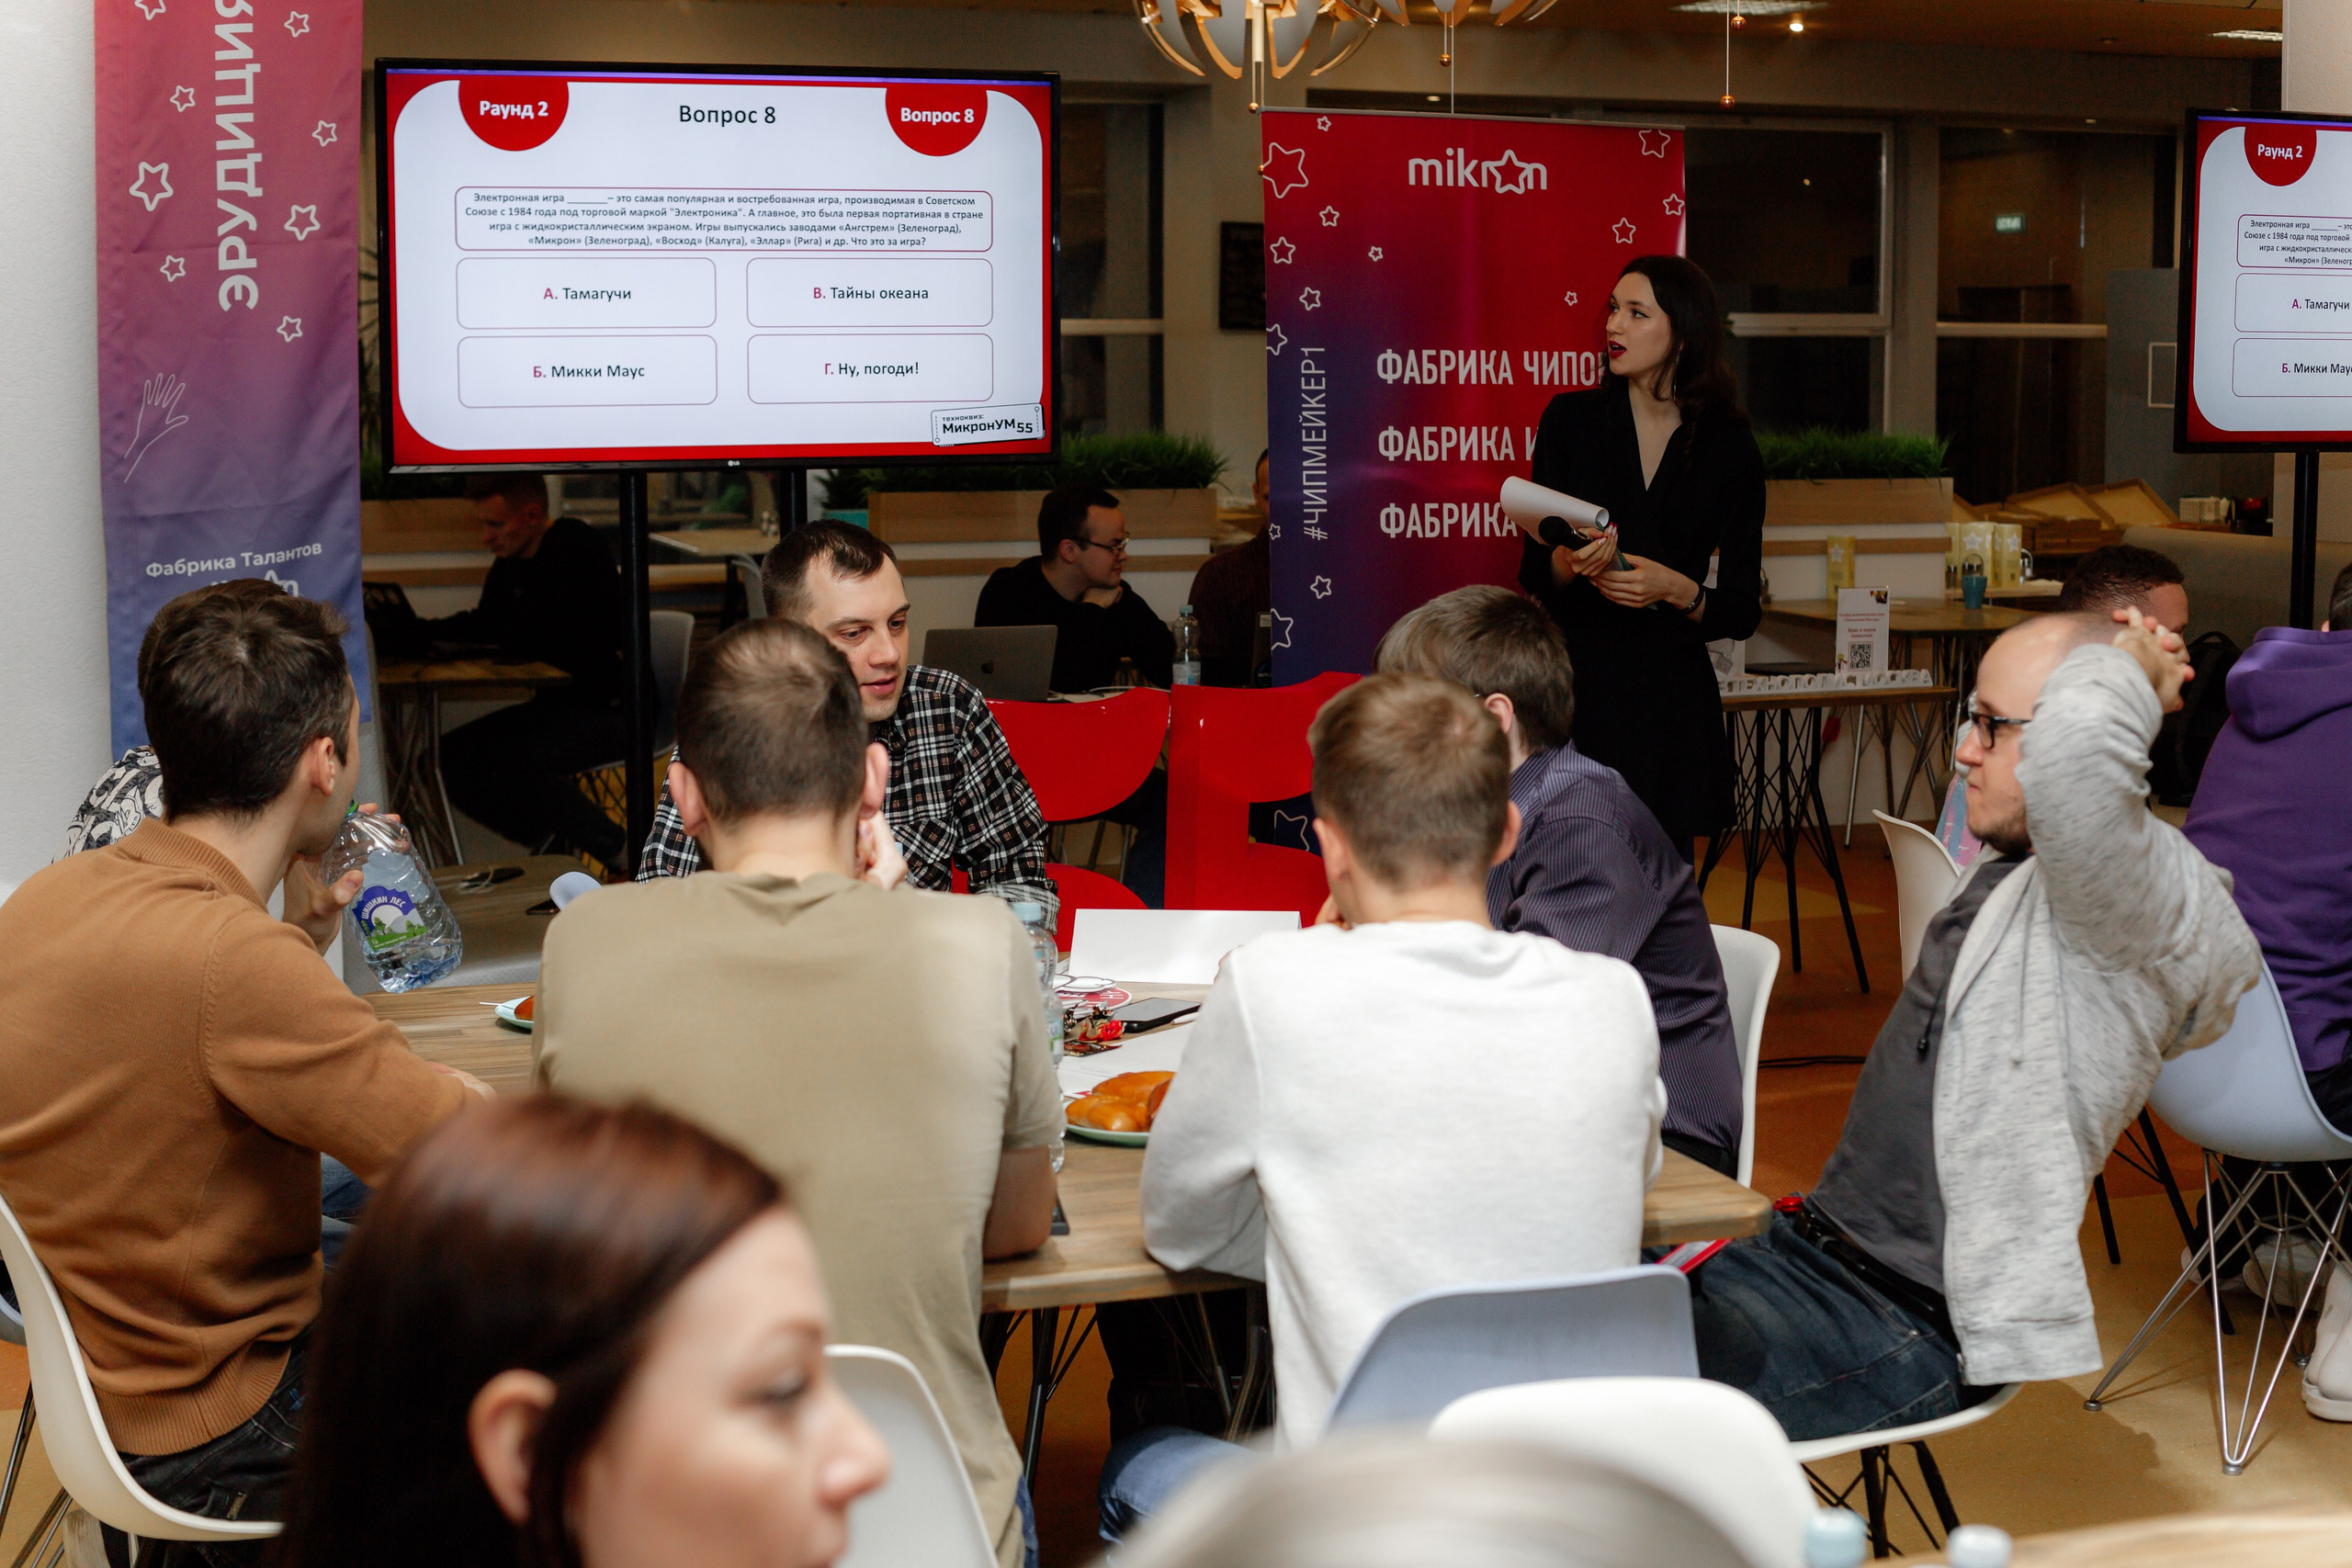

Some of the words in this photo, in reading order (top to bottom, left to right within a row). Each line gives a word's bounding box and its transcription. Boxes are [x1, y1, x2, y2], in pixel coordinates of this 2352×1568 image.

[479, 99, 534, 120] Раунд
[537, 101, 548, 118] 2
[678, 104, 759, 129] Вопрос
[763, 106, 776, 124] 8
[900, 106, 959, 127] Вопрос
[963, 107, 975, 123] 8
[215, 0, 263, 311] ЭРУДИЦИЯ
[2257, 143, 2294, 161] Раунд
[2296, 145, 2302, 158] 2
[474, 193, 539, 203] Электронная
[542, 196, 564, 204] игра
[667, 197, 725, 205] популярная
[737, 195, 815, 205] востребованная
[818, 197, 842, 206] игра,
[845, 197, 915, 206] производимая
[926, 197, 975, 205] Советском
[466, 208, 497, 216] Союзе
[509, 208, 531, 216] 1984
[535, 209, 557, 218] года
[560, 209, 579, 218] под
[581, 208, 626, 218] торговой
[629, 208, 667, 218] маркой
[670, 209, 745, 219] "Электроника".
[748, 209, 755, 217] А
[758, 210, 798, 219] главное,
[819, 209, 843, 218] была
[846, 211, 879, 220] первая
[882, 211, 942, 220] портативная
[952, 212, 983, 220] стране
[522, 224, 644, 232] жидкокристаллическим
[647, 224, 692, 232] экраном.
[695, 223, 720, 232] Игры
[724, 224, 786, 232] выпускались
[839, 223, 895, 233] «Ангстрем»
[898, 223, 961, 234] (Зеленоград),
[2250, 220, 2293, 229] Электронная
[528, 236, 582, 246] «Микрон»
[584, 235, 652, 246] (Зеленоград),
[655, 236, 702, 246] «Восход»
[706, 236, 747, 246] (Калуга),
[751, 237, 791, 246] «Эллар»
[794, 236, 821, 247] (Рига)
[833, 239, 848, 247] др.
[851, 237, 867, 245] Что
[900, 237, 926, 247] игра?
[2320, 234, 2349, 243] торговой
[2285, 256, 2319, 265] «Микрон»
[543, 287, 559, 301] А.
[562, 287, 632, 305] Тамагучи
[813, 286, 827, 300] В.
[830, 286, 876, 305] Тайны
[878, 288, 930, 300] океана
[2291, 299, 2302, 310] А.
[2304, 299, 2350, 311] Тамагучи
[533, 365, 547, 379] Б.
[551, 364, 603, 379] Микки
[606, 365, 646, 384] Маус
[823, 363, 834, 377] Г.
[838, 362, 861, 378] Ну,
[864, 361, 920, 382] погоди!
[1376, 348, 1513, 386] ФАБРИКА
[2281, 363, 2291, 374] Б.
[2294, 363, 2327, 374] Микки
[2330, 363, 2352, 377] Мау
[942, 413, 985, 423] техноквиз:
[1300, 346, 1329, 541] #ЧИПМЕЙКЕР1
[1378, 424, 1515, 462] ФАБРИКА
[145, 557, 236, 578] Фабрика
[240, 542, 322, 568] Талантов
[361, 896, 388, 920] ШИШКИН
[390, 897, 406, 908] ЛЕС
